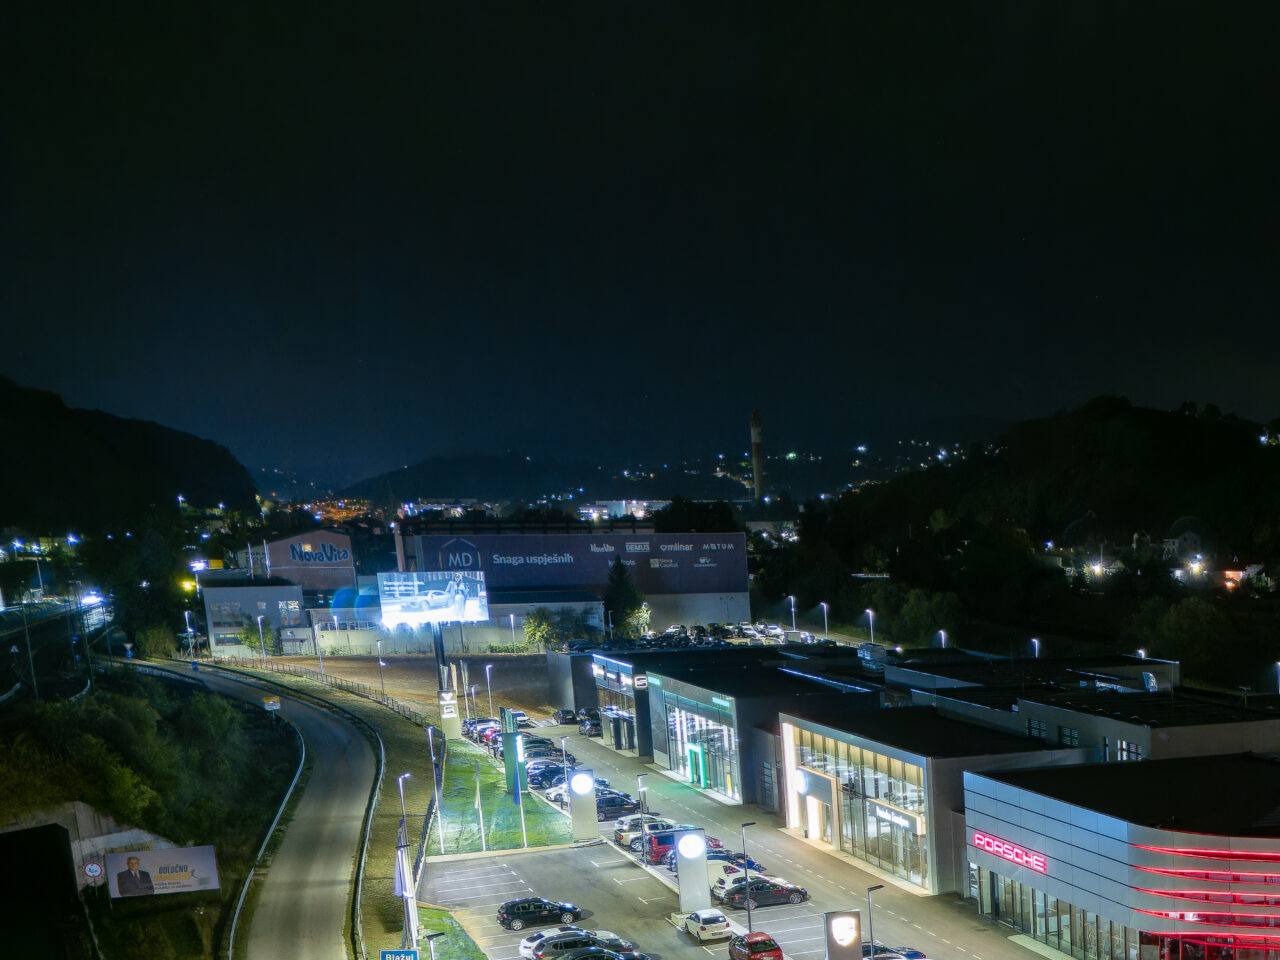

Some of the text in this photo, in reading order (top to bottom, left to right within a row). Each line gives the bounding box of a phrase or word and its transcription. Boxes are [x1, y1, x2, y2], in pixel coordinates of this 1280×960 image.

[289, 542, 349, 563] NovaVita
[449, 552, 473, 567] MD
[493, 553, 574, 566] Snaga uspješnih
[974, 831, 1047, 873] PORSCHE
